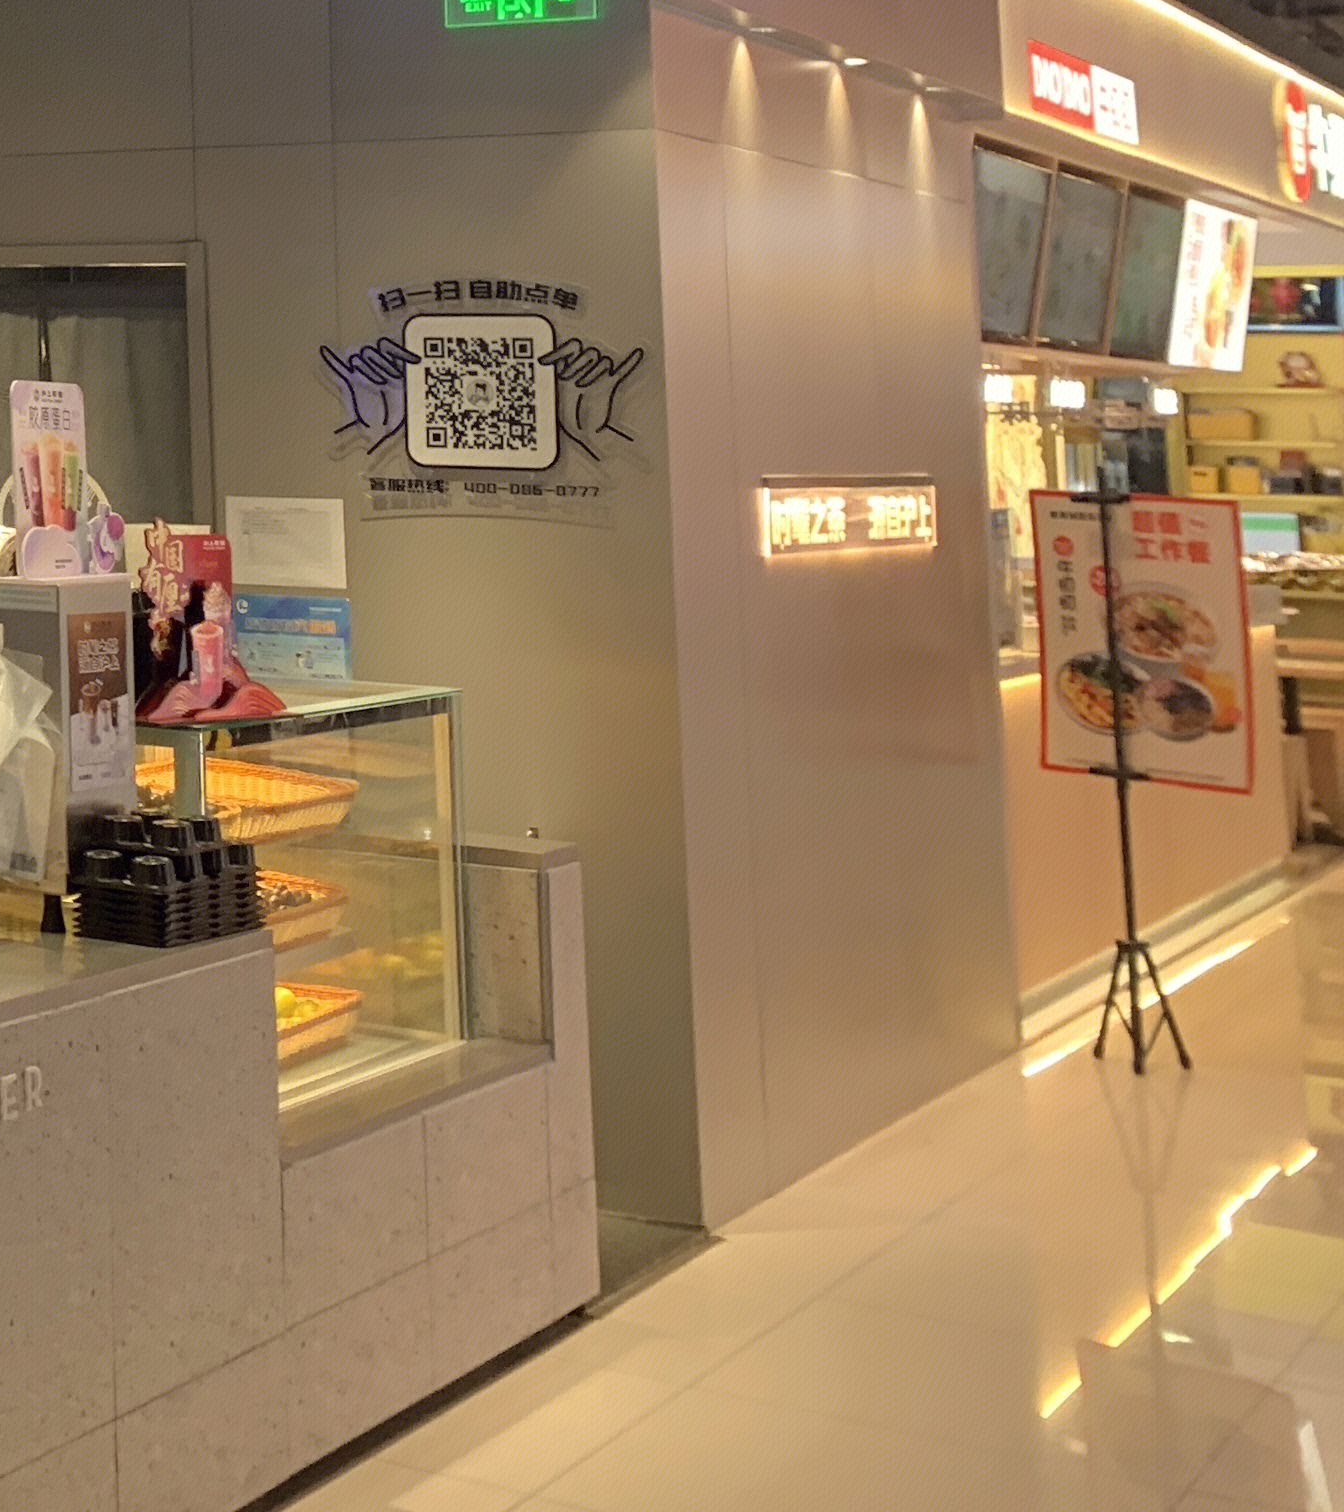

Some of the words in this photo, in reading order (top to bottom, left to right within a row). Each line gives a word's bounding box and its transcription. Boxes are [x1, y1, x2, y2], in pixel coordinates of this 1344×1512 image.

[378, 280, 461, 312] 扫一扫
[469, 279, 580, 311] 自助点单
